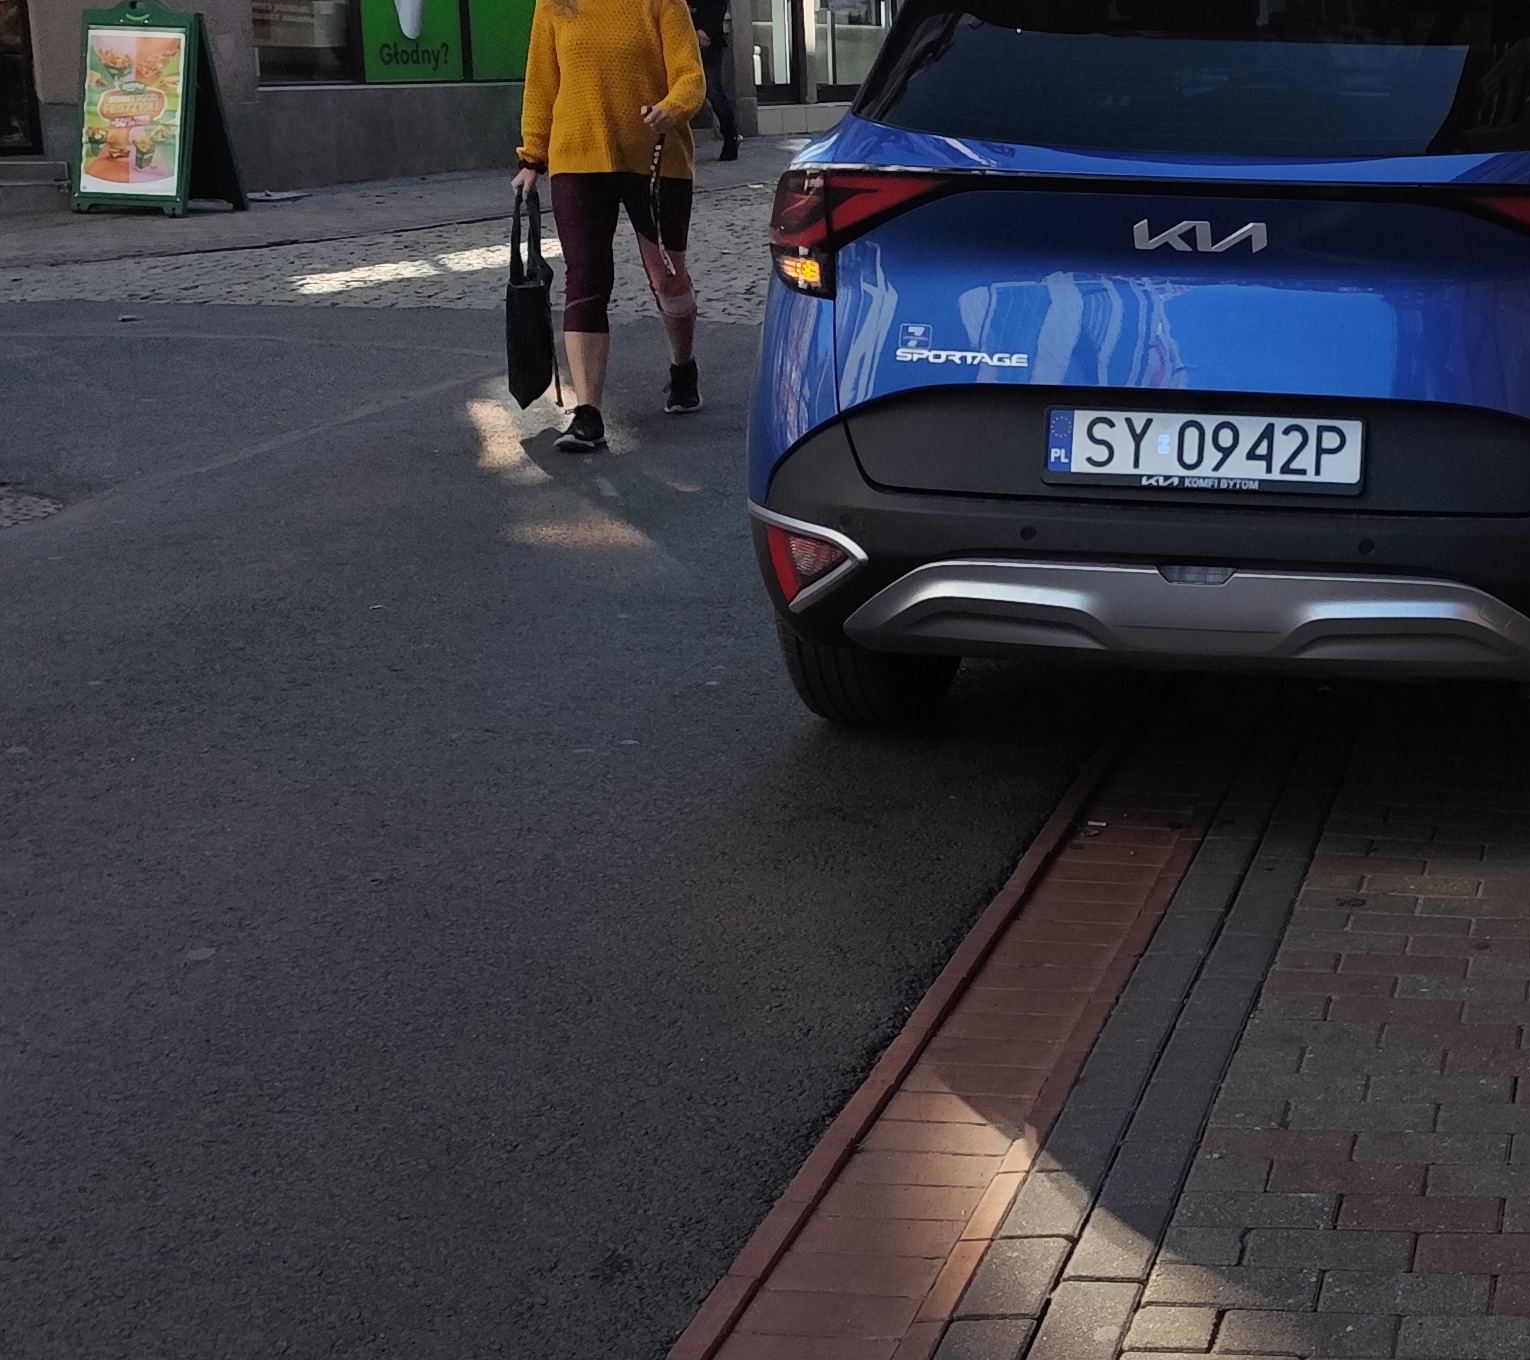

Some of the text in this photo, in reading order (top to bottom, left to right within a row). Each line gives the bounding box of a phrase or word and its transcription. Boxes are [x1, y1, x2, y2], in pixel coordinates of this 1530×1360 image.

[380, 42, 449, 70] Głodny?
[1133, 218, 1268, 253] KIA
[896, 348, 1028, 367] SPORTAGE
[1051, 448, 1069, 463] PL
[1085, 416, 1347, 476] SY 0942P
[1220, 479, 1259, 490] BYTOM
